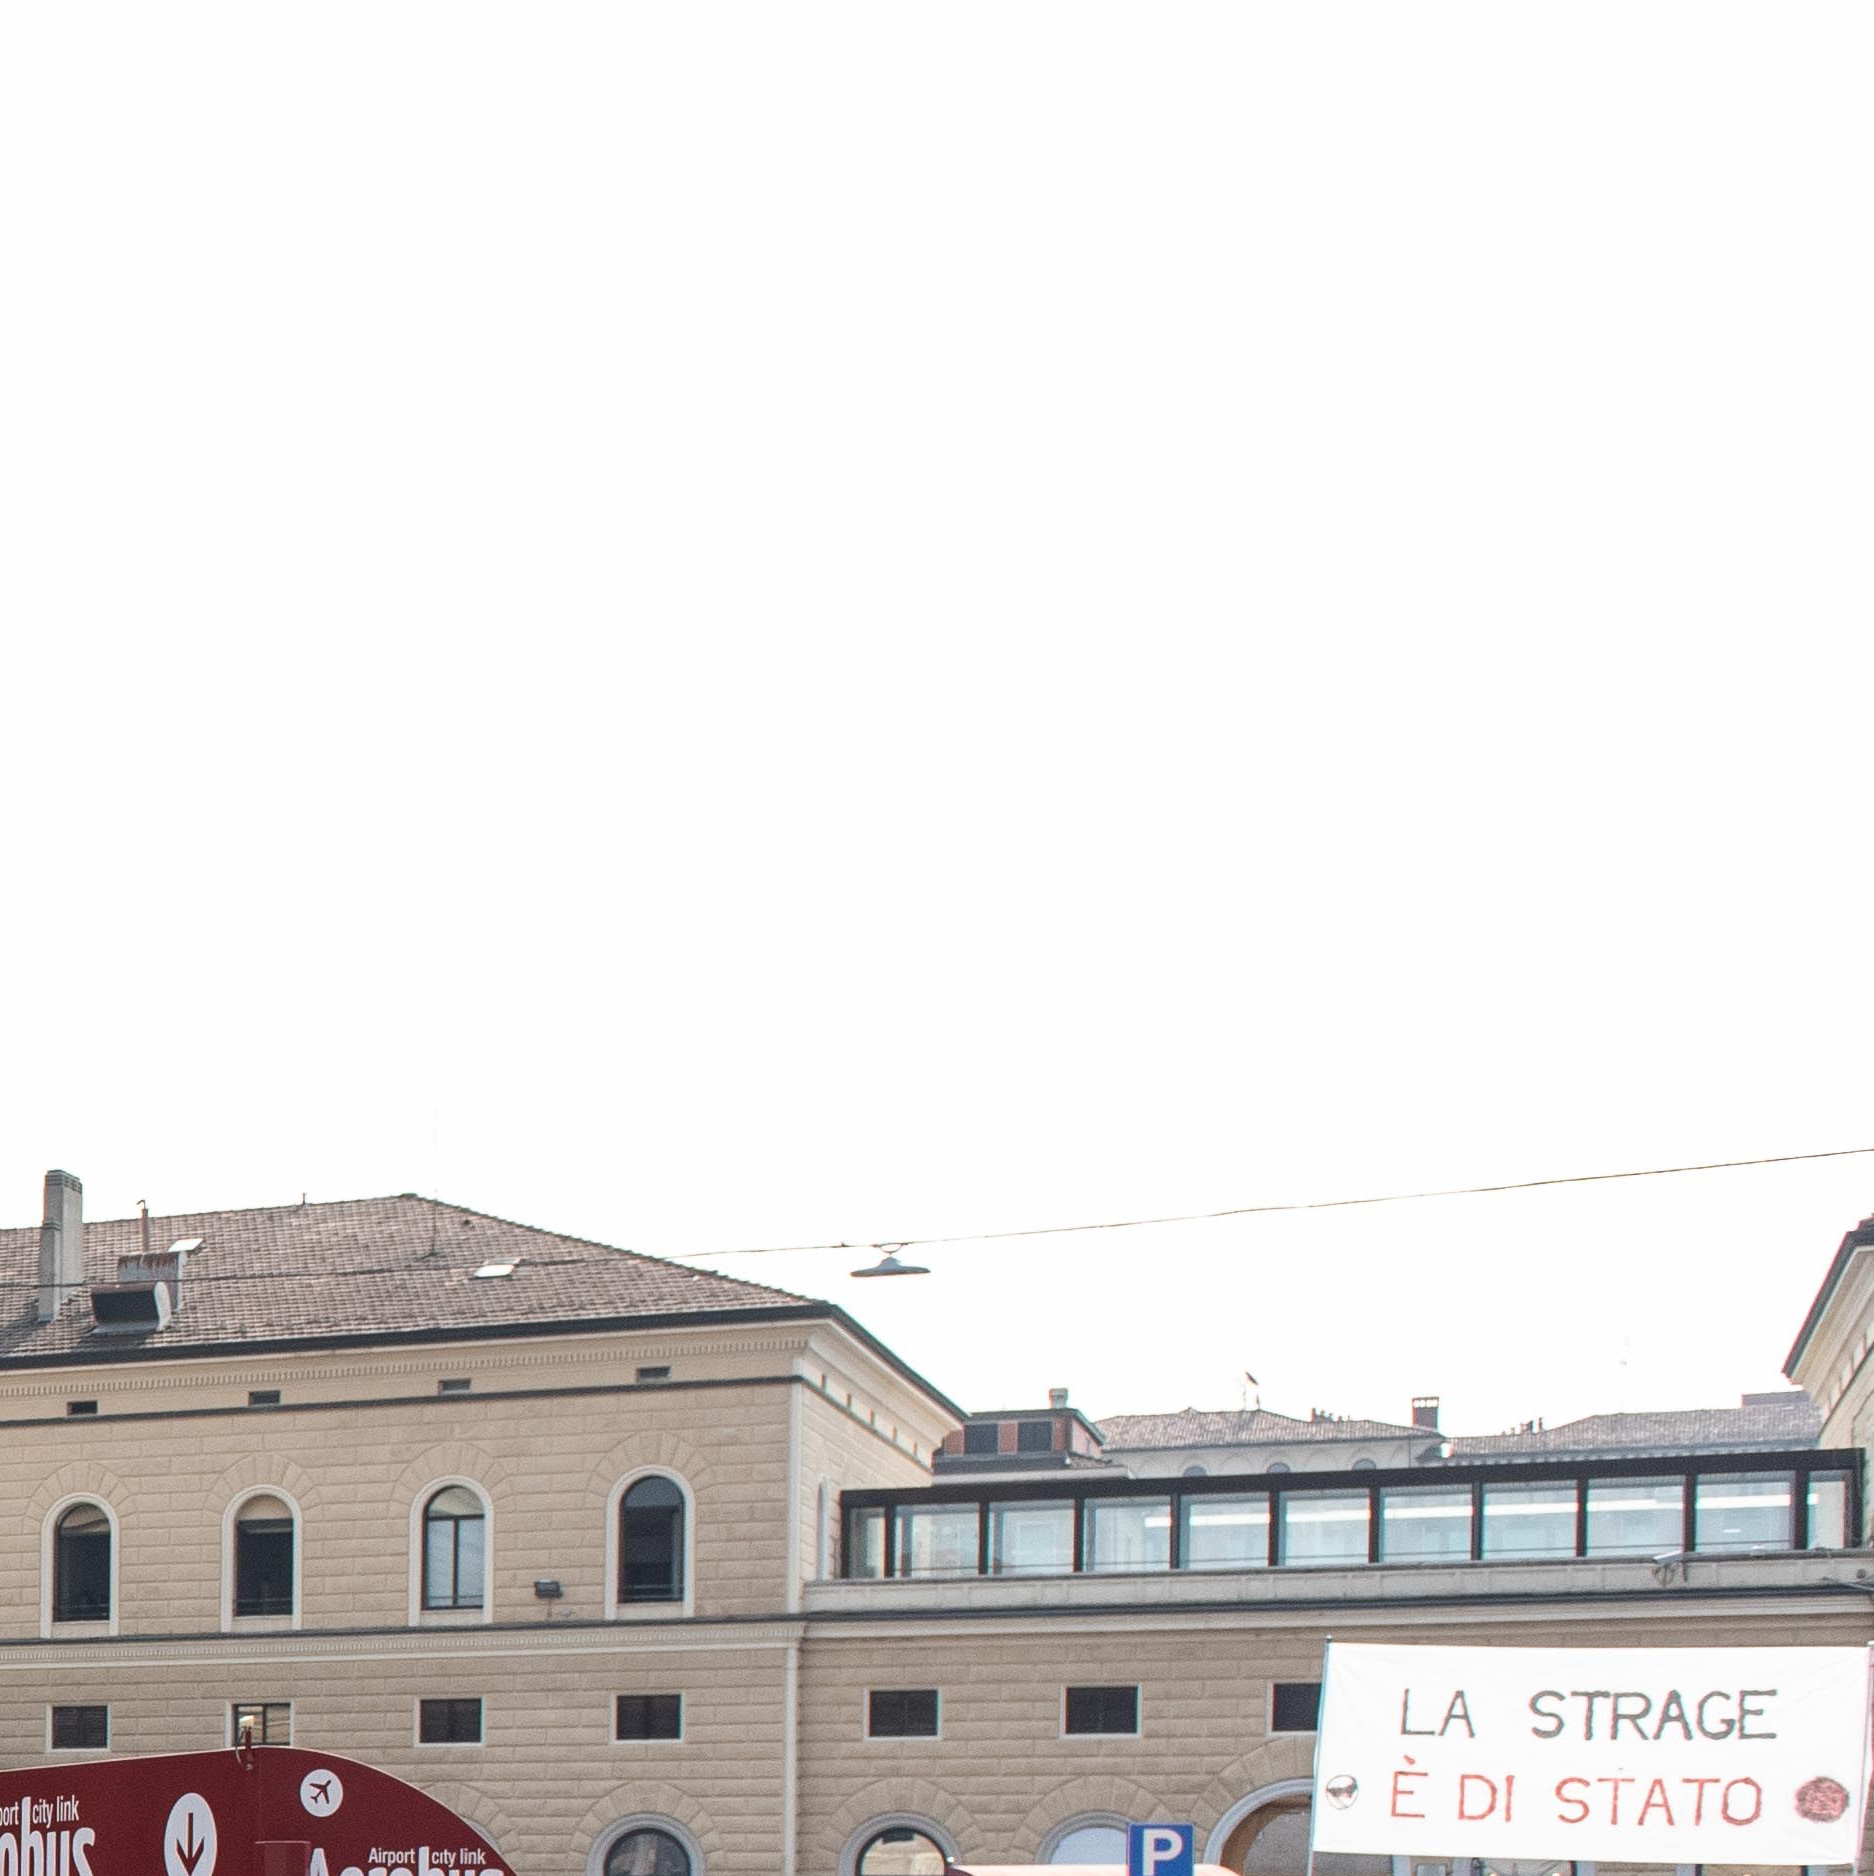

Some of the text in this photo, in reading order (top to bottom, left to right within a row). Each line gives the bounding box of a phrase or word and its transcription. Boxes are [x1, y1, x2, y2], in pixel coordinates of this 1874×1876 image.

[1399, 1687, 1779, 1741] LA STRAGE
[32, 1798, 54, 1829] city
[56, 1794, 80, 1822] link
[1389, 1754, 1764, 1827] È DI STATO
[368, 1847, 487, 1868] Airport city link
